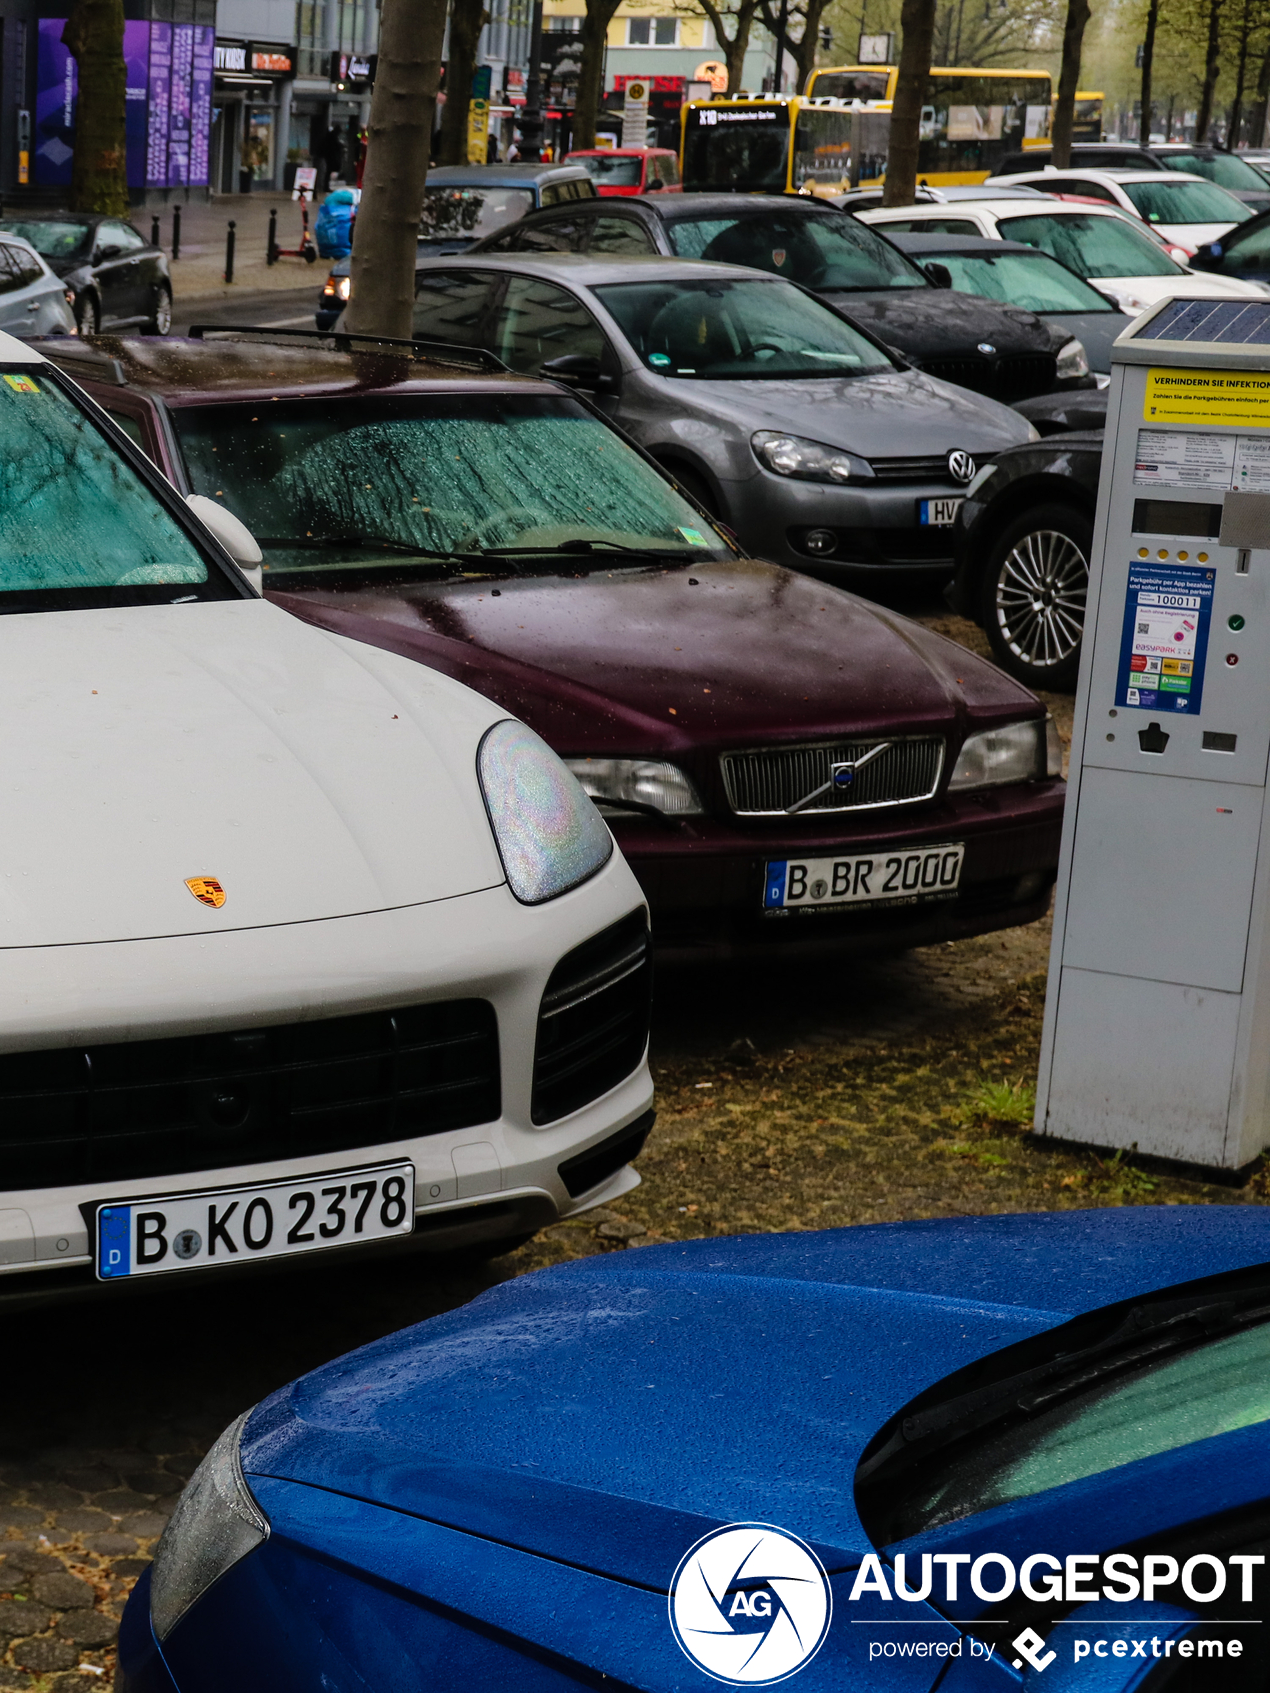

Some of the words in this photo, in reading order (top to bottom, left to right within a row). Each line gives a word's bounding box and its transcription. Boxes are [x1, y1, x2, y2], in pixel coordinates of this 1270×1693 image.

[613, 74, 686, 92] HSE
[699, 110, 717, 125] X10
[1154, 377, 1210, 387] VERHINDERN
[1212, 379, 1224, 387] SIE
[934, 501, 955, 521] HV
[1130, 576, 1162, 585] Parkgebühr
[1187, 581, 1212, 589] bezahlen
[1159, 586, 1188, 594] kontaktlos
[1190, 588, 1212, 596] parken!
[1157, 595, 1197, 607] 100011
[772, 888, 779, 899] D
[787, 865, 808, 900] B
[831, 860, 873, 897] BR
[882, 852, 959, 893] 2000
[109, 1250, 121, 1264] D
[136, 1211, 168, 1265] B
[208, 1197, 273, 1255] KO
[287, 1176, 406, 1244] 2378
